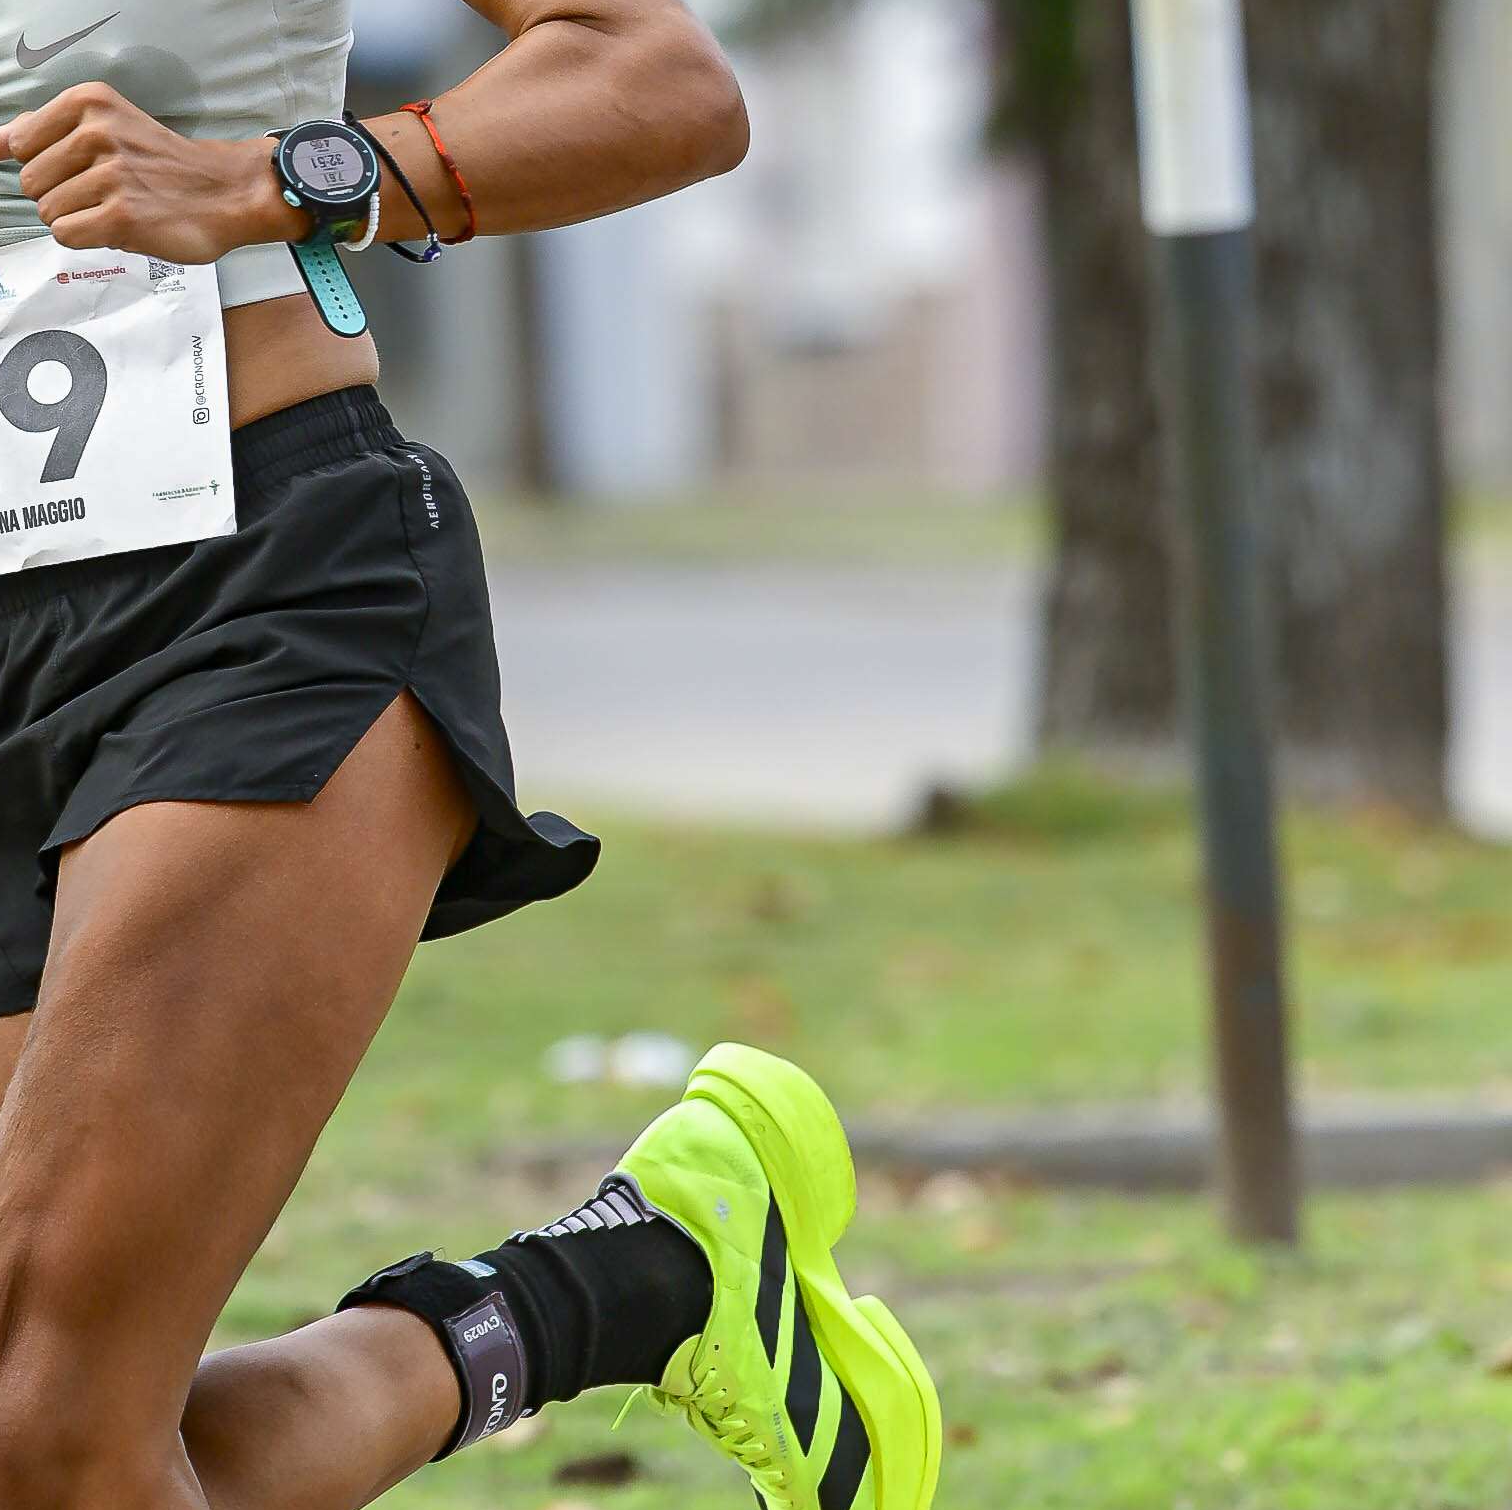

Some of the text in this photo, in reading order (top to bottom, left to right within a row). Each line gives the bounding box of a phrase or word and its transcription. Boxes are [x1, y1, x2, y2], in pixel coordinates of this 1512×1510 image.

[72, 271, 82, 280] la
[191, 335, 206, 405] @CRONORAV
[22, 496, 87, 530] MAGGIO
[463, 1315, 500, 1343] CV029
